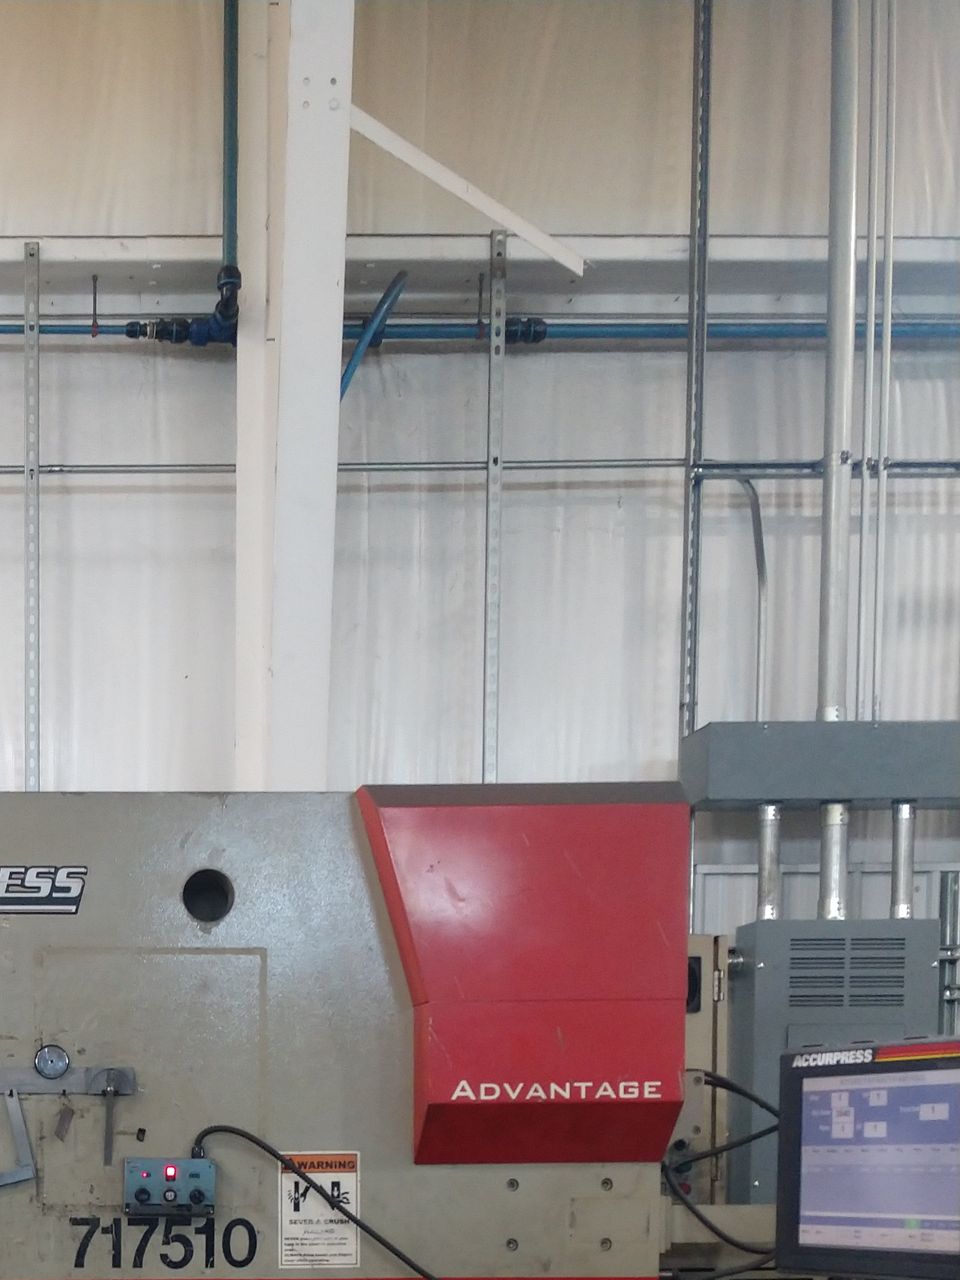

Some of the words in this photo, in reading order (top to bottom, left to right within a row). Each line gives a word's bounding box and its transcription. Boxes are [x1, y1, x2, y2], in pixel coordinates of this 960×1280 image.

[791, 1048, 873, 1068] ACCURPRESS
[450, 1080, 662, 1101] ADVANTAGE
[297, 1160, 355, 1170] WARNING
[69, 1217, 258, 1270] 717510
